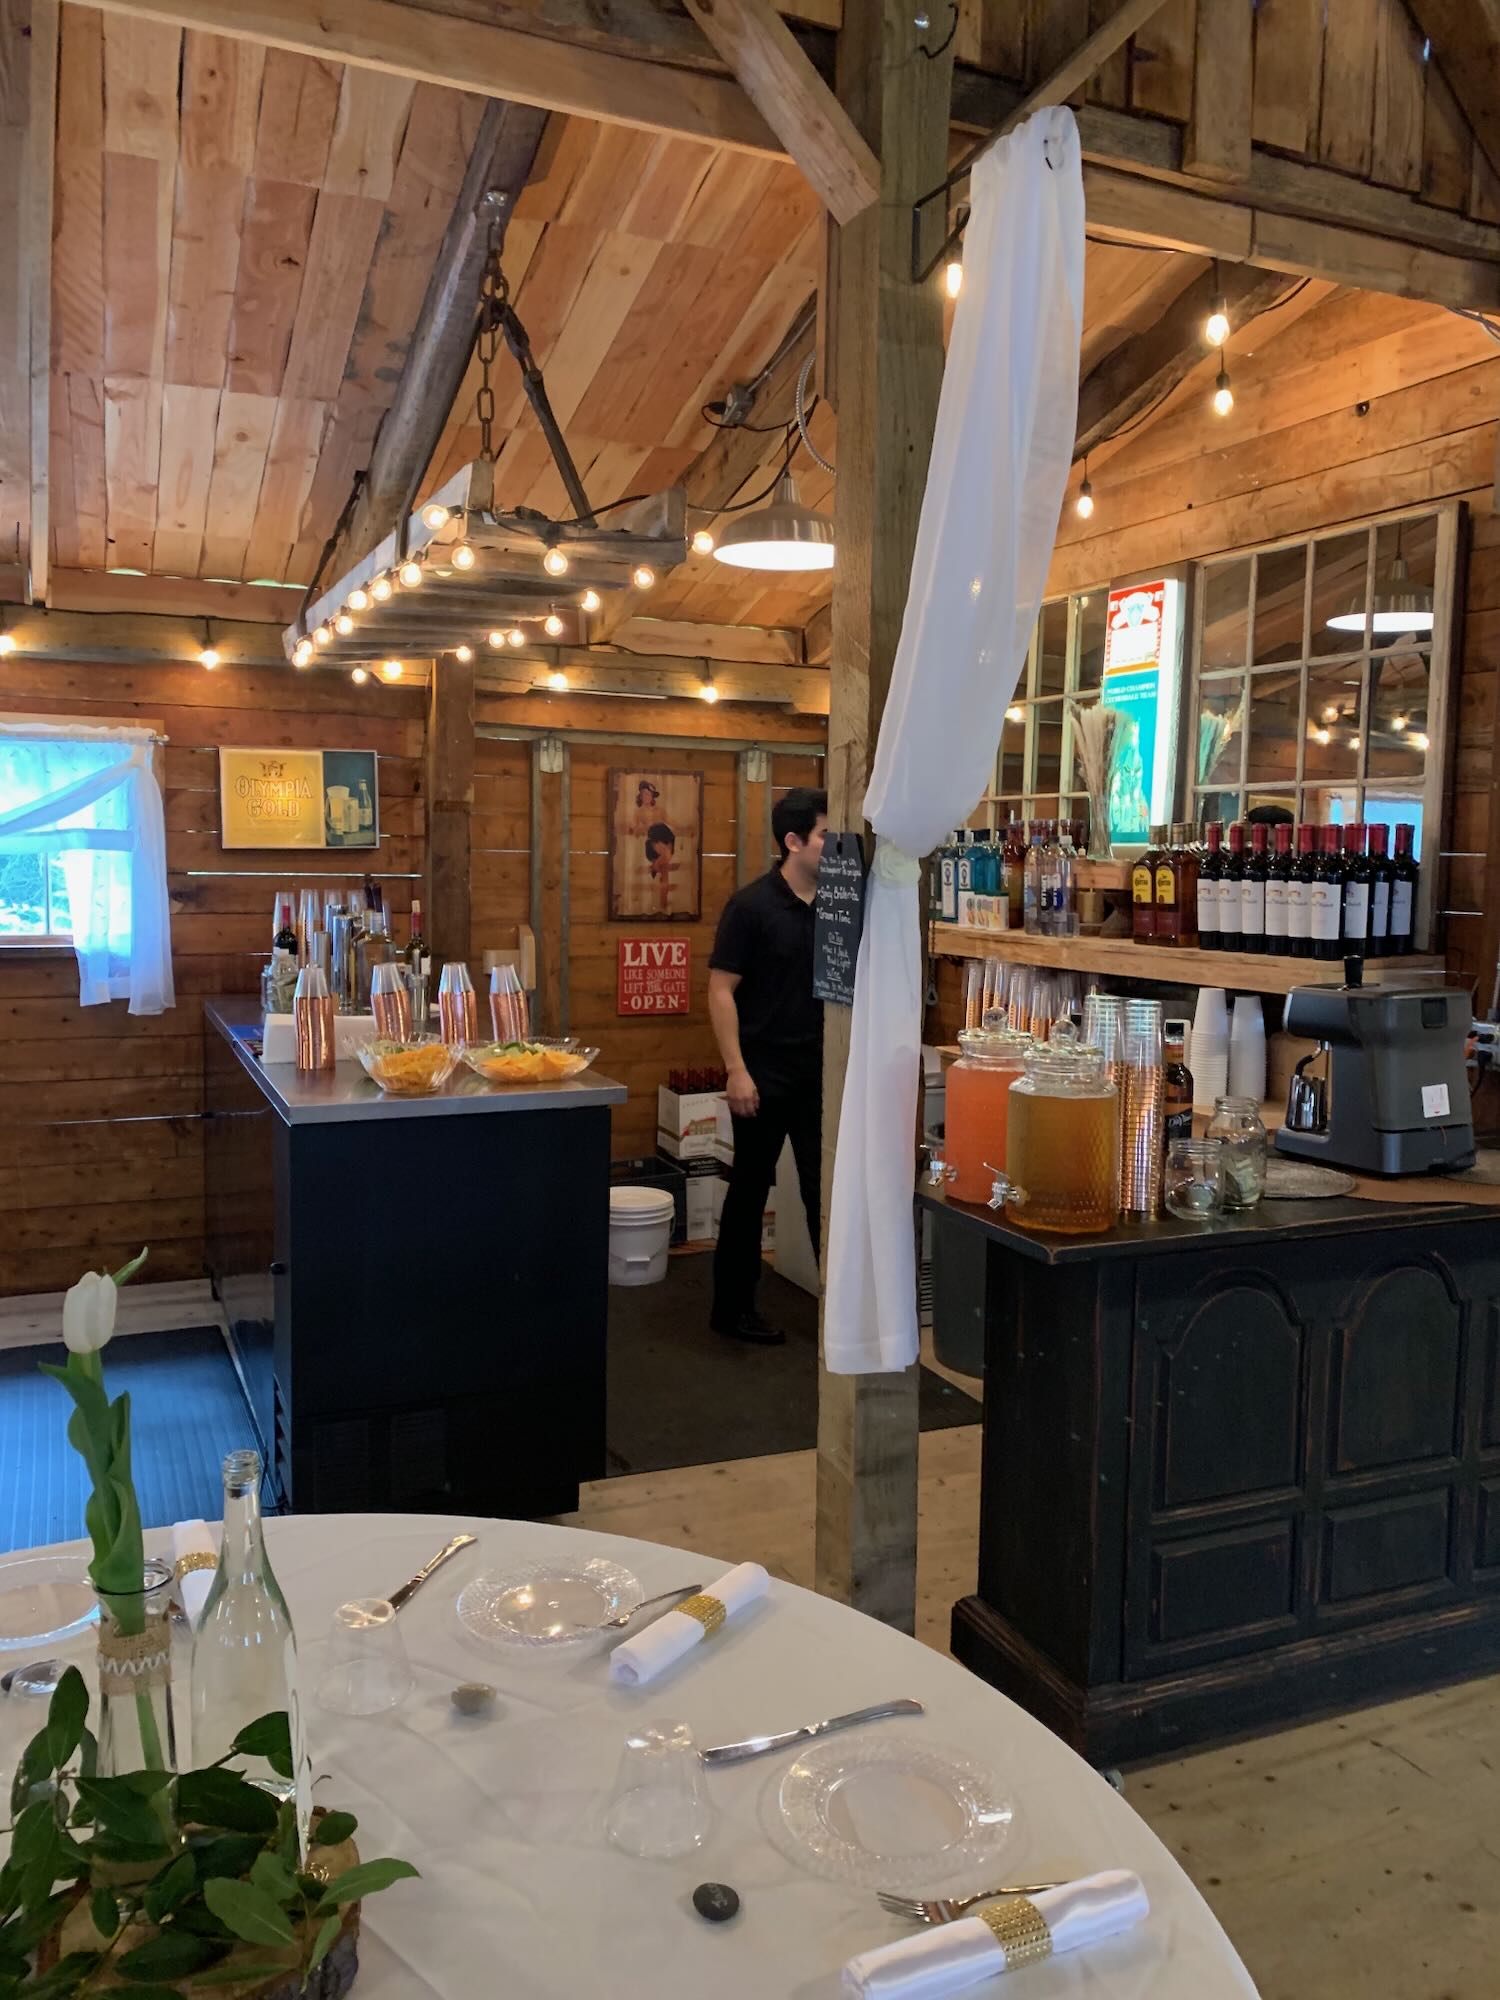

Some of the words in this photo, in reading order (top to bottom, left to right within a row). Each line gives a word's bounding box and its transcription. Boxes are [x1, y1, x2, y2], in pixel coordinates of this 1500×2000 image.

[234, 775, 313, 798] OLYMPIA
[247, 799, 299, 817] GOLD
[623, 942, 687, 967] LIVE
[624, 969, 643, 980] LIKE
[646, 968, 686, 979] SOMEONE
[624, 982, 644, 993] LEFT
[663, 981, 686, 993] GATE
